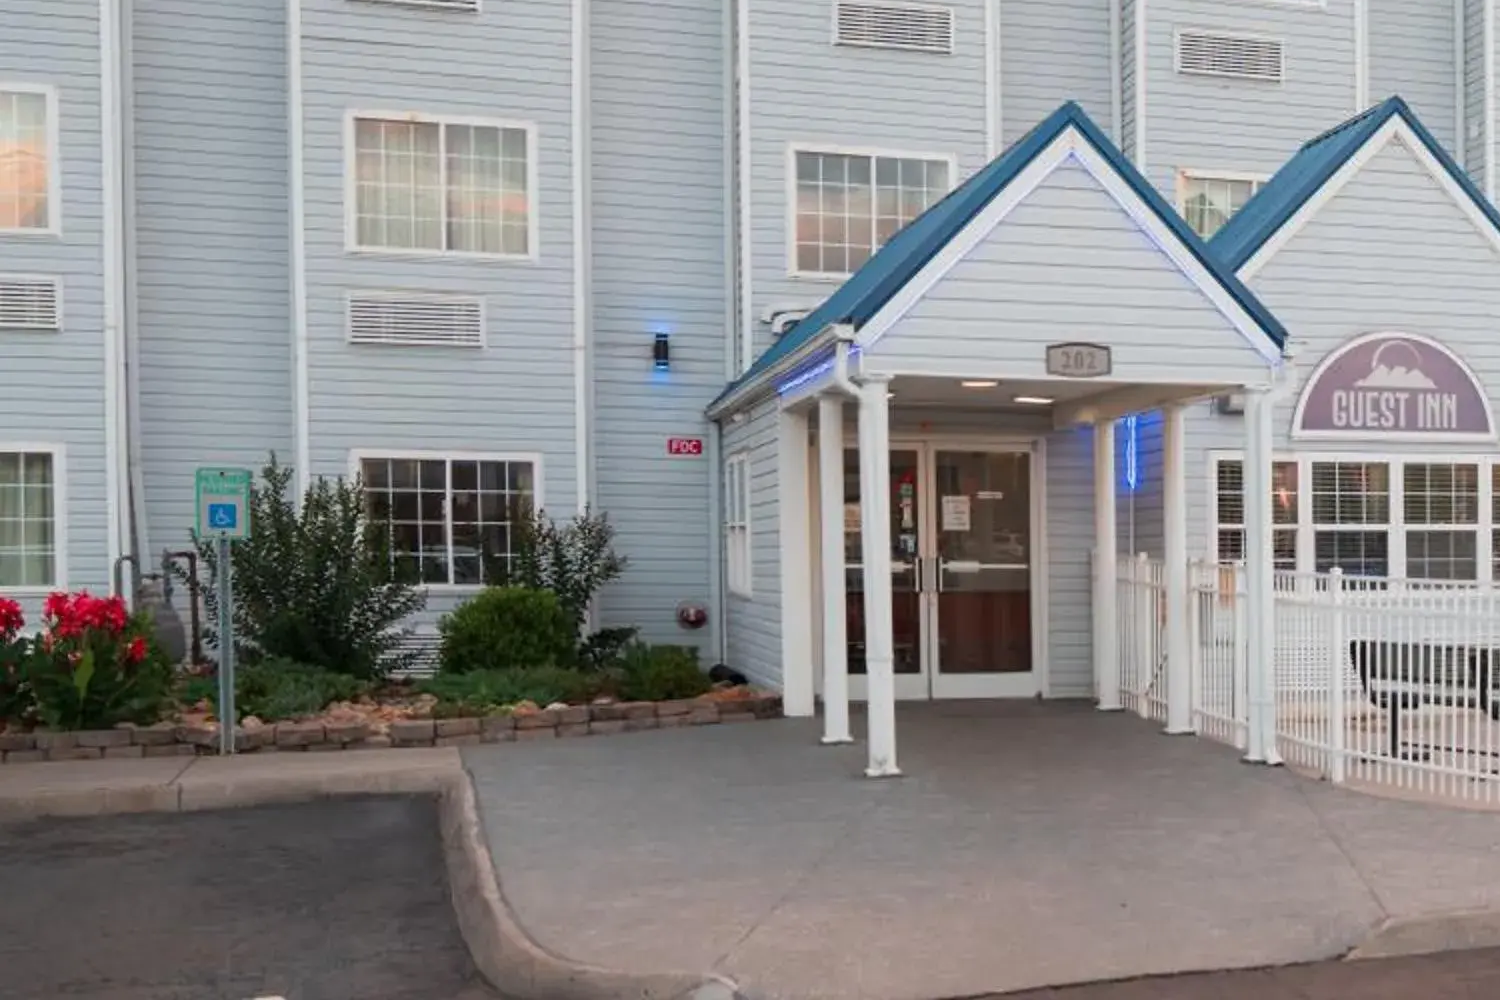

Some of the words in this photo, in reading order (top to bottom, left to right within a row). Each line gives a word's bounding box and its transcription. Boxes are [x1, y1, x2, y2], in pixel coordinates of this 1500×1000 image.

[1061, 350, 1098, 370] 202
[1332, 389, 1410, 428] GUEST
[1418, 392, 1457, 429] INN
[671, 440, 698, 453] FDC
